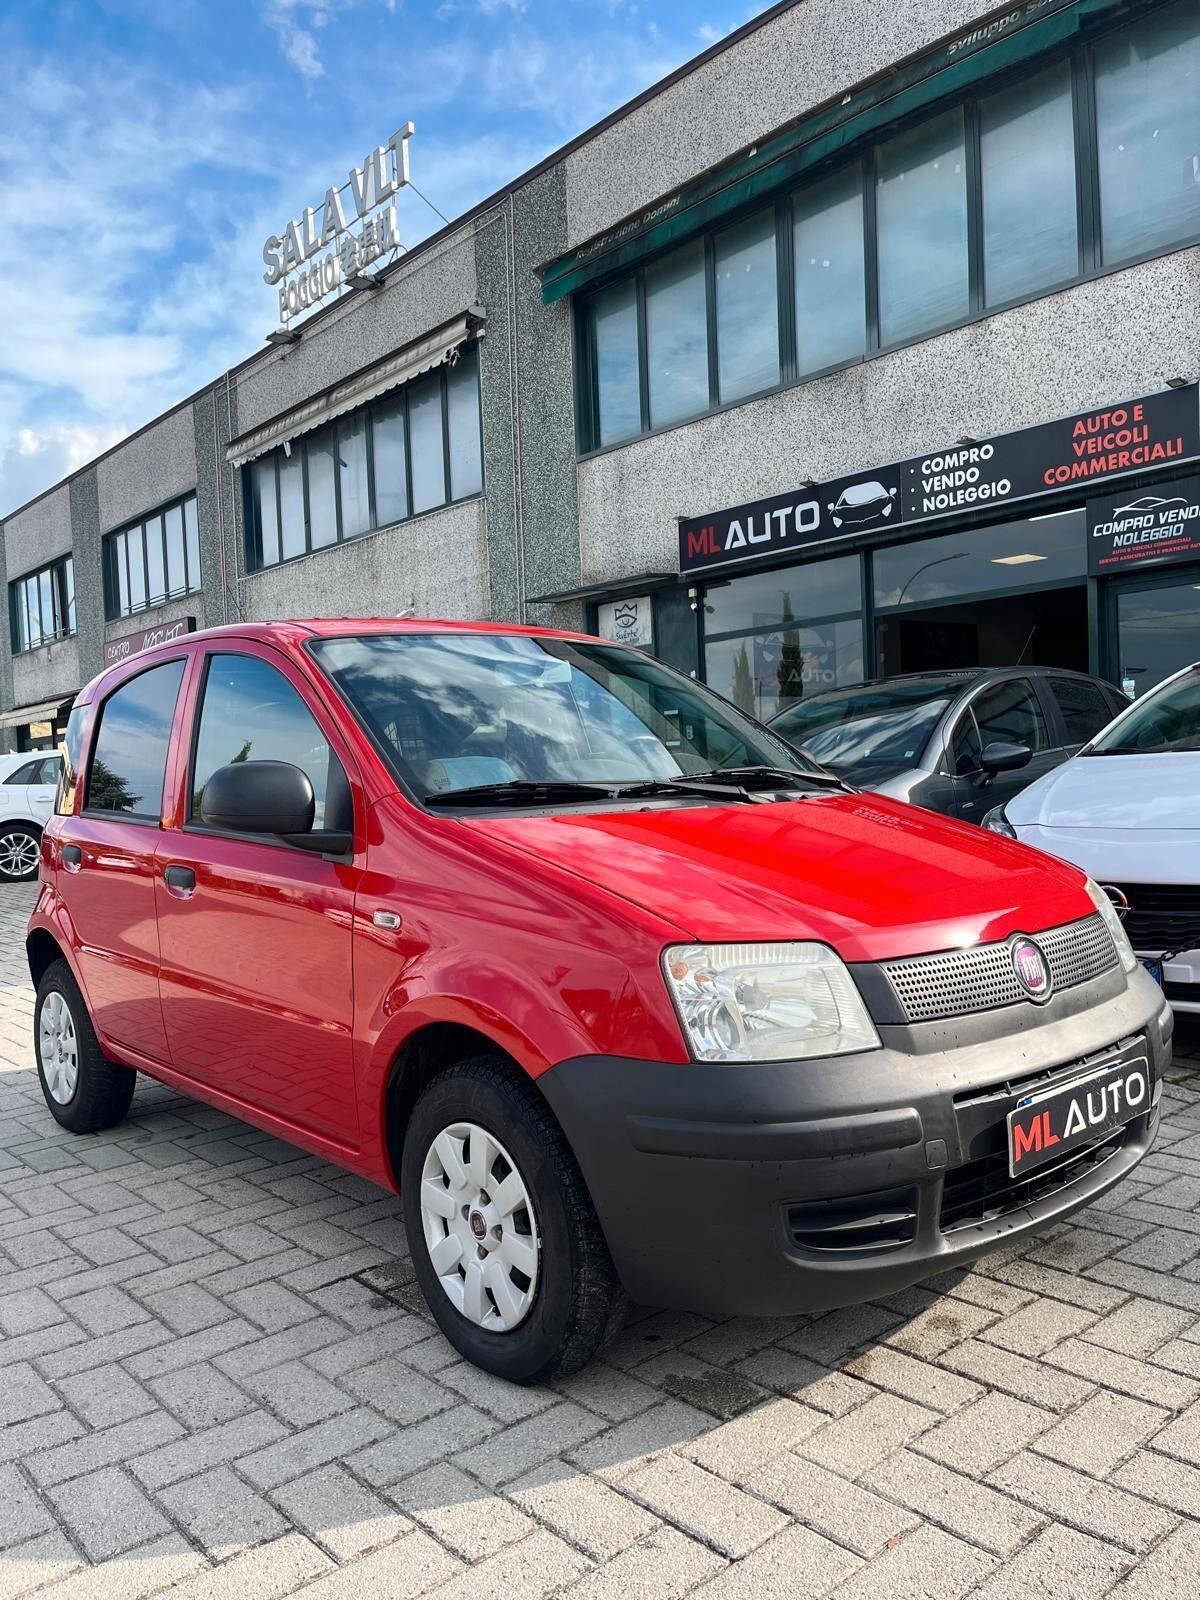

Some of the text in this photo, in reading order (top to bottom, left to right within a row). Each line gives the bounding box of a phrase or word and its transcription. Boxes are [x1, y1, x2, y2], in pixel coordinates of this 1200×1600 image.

[947, 11, 1020, 55] Sviluppo
[263, 121, 414, 285] SALA VLT
[643, 194, 680, 223] Domini
[279, 252, 341, 323] POGGIO
[1072, 404, 1144, 438] AUTO E
[1072, 424, 1149, 457] VEICOLI
[921, 444, 994, 475] COMPRO
[1043, 437, 1184, 485] COMMERCIALI
[921, 467, 980, 493] VENDO
[923, 478, 1011, 512] NOLEGGIO
[687, 500, 820, 558] ML AUTO
[1093, 505, 1200, 537] COMPRO VEND
[1113, 523, 1184, 547] NOLEGGIO
[1132, 544, 1153, 552] VEICOLI
[108, 641, 130, 658] CENTRO
[787, 668, 835, 682] AUTO
[1013, 1071, 1145, 1162] ML AUTO
